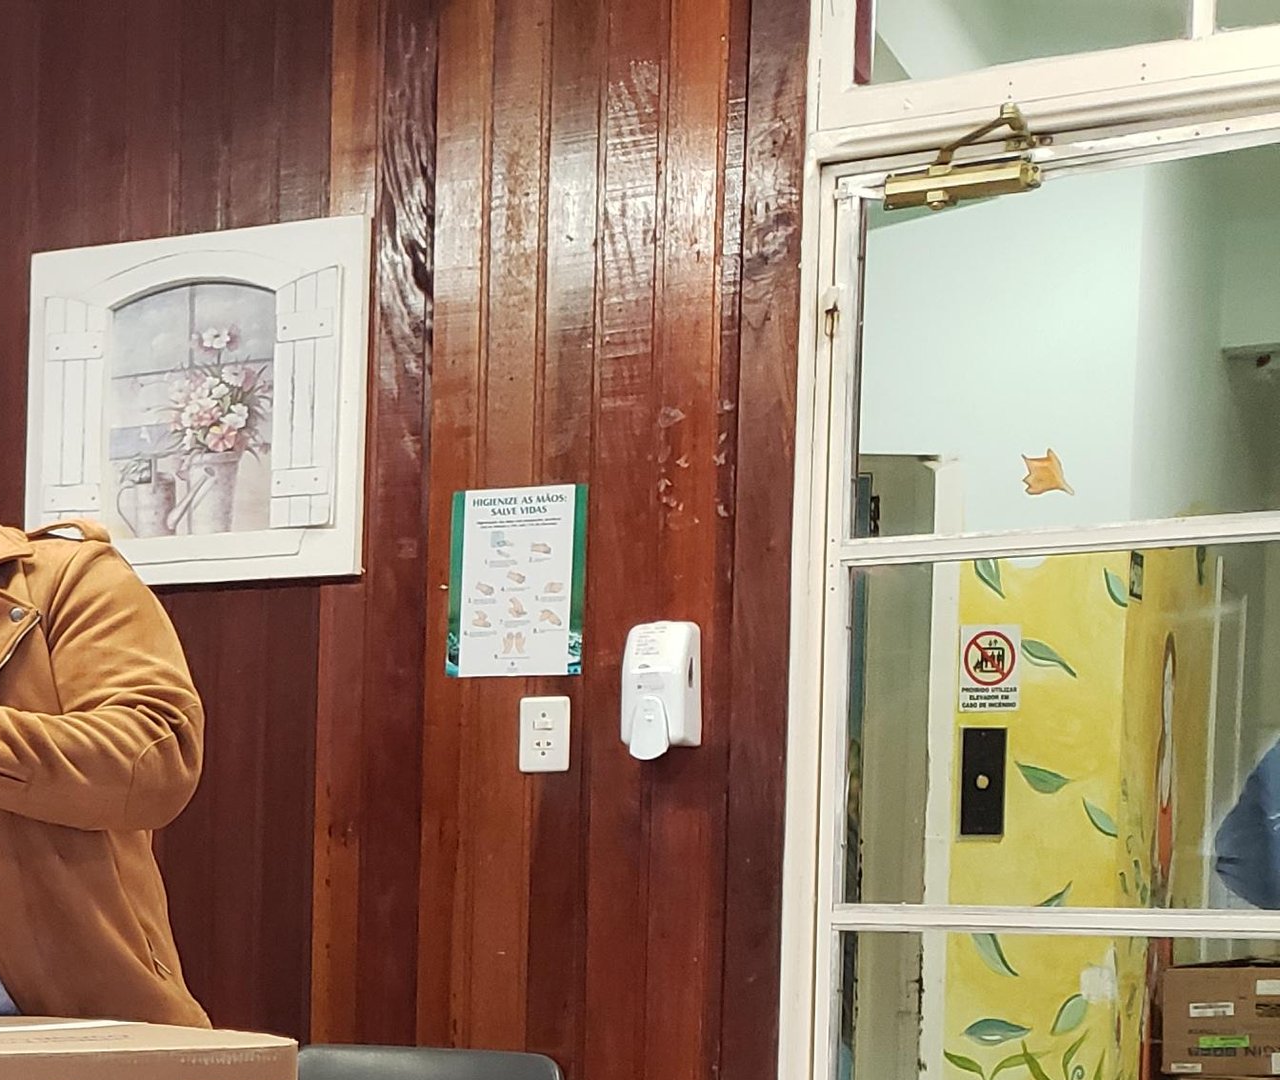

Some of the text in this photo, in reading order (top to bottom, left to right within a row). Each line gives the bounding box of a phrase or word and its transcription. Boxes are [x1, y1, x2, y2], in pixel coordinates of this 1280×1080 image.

[472, 497, 517, 507] HIGIENIZE
[521, 496, 533, 504] AS
[491, 505, 547, 516] SALVE VIDAS
